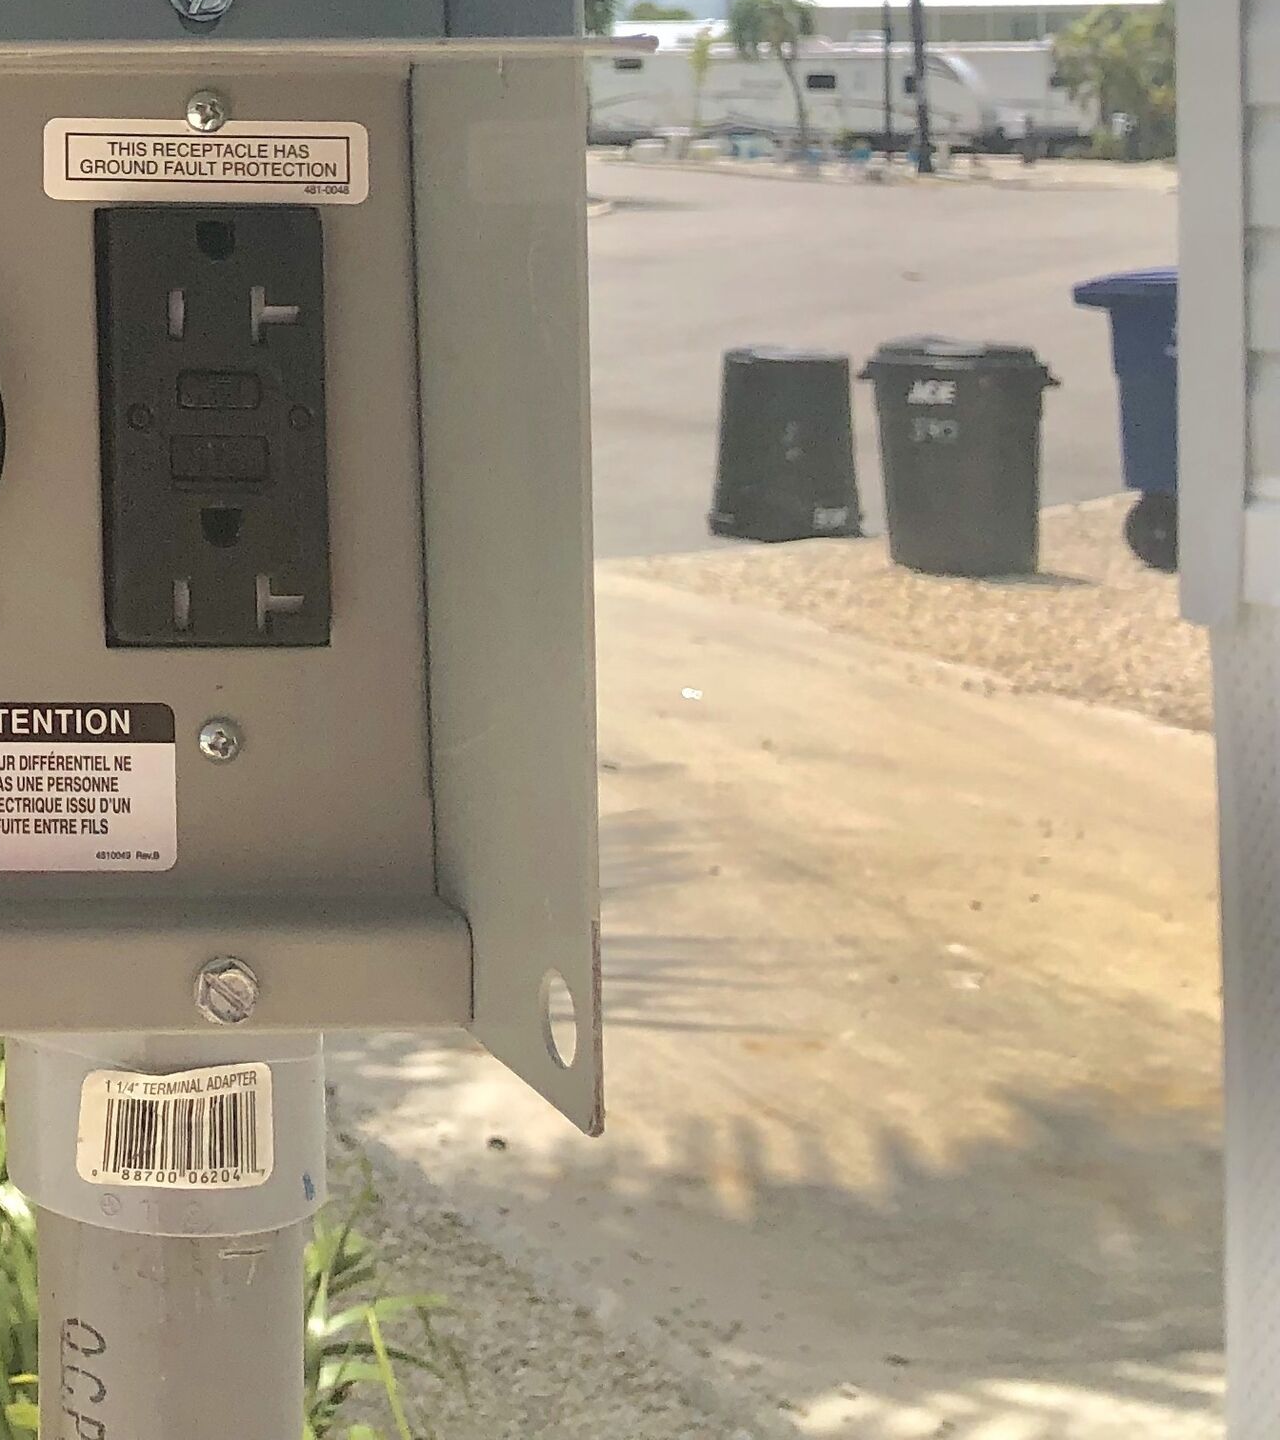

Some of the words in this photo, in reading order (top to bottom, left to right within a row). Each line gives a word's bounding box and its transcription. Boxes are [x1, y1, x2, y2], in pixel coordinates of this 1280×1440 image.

[108, 142, 148, 156] THIS
[153, 142, 268, 159] RECEPTACLE
[273, 144, 309, 159] HAS
[80, 160, 159, 175] GROUND
[163, 161, 218, 176] FAULT
[223, 163, 337, 177] PROTECTION
[19, 751, 111, 771] DIFFÉRENTIEL
[114, 756, 132, 772] NE
[17, 777, 43, 791] UNE
[47, 777, 118, 792] PERSONNE
[66, 797, 96, 813] ISSU
[100, 797, 131, 814] D'UN
[34, 818, 77, 835] ENTRE
[81, 818, 108, 835] FILS
[105, 1080, 111, 1093] 1
[144, 1080, 203, 1095] TERMINAL
[207, 1071, 257, 1090] ADAPTER
[122, 1170, 177, 1183] 88700
[189, 1170, 240, 1184] 06204
